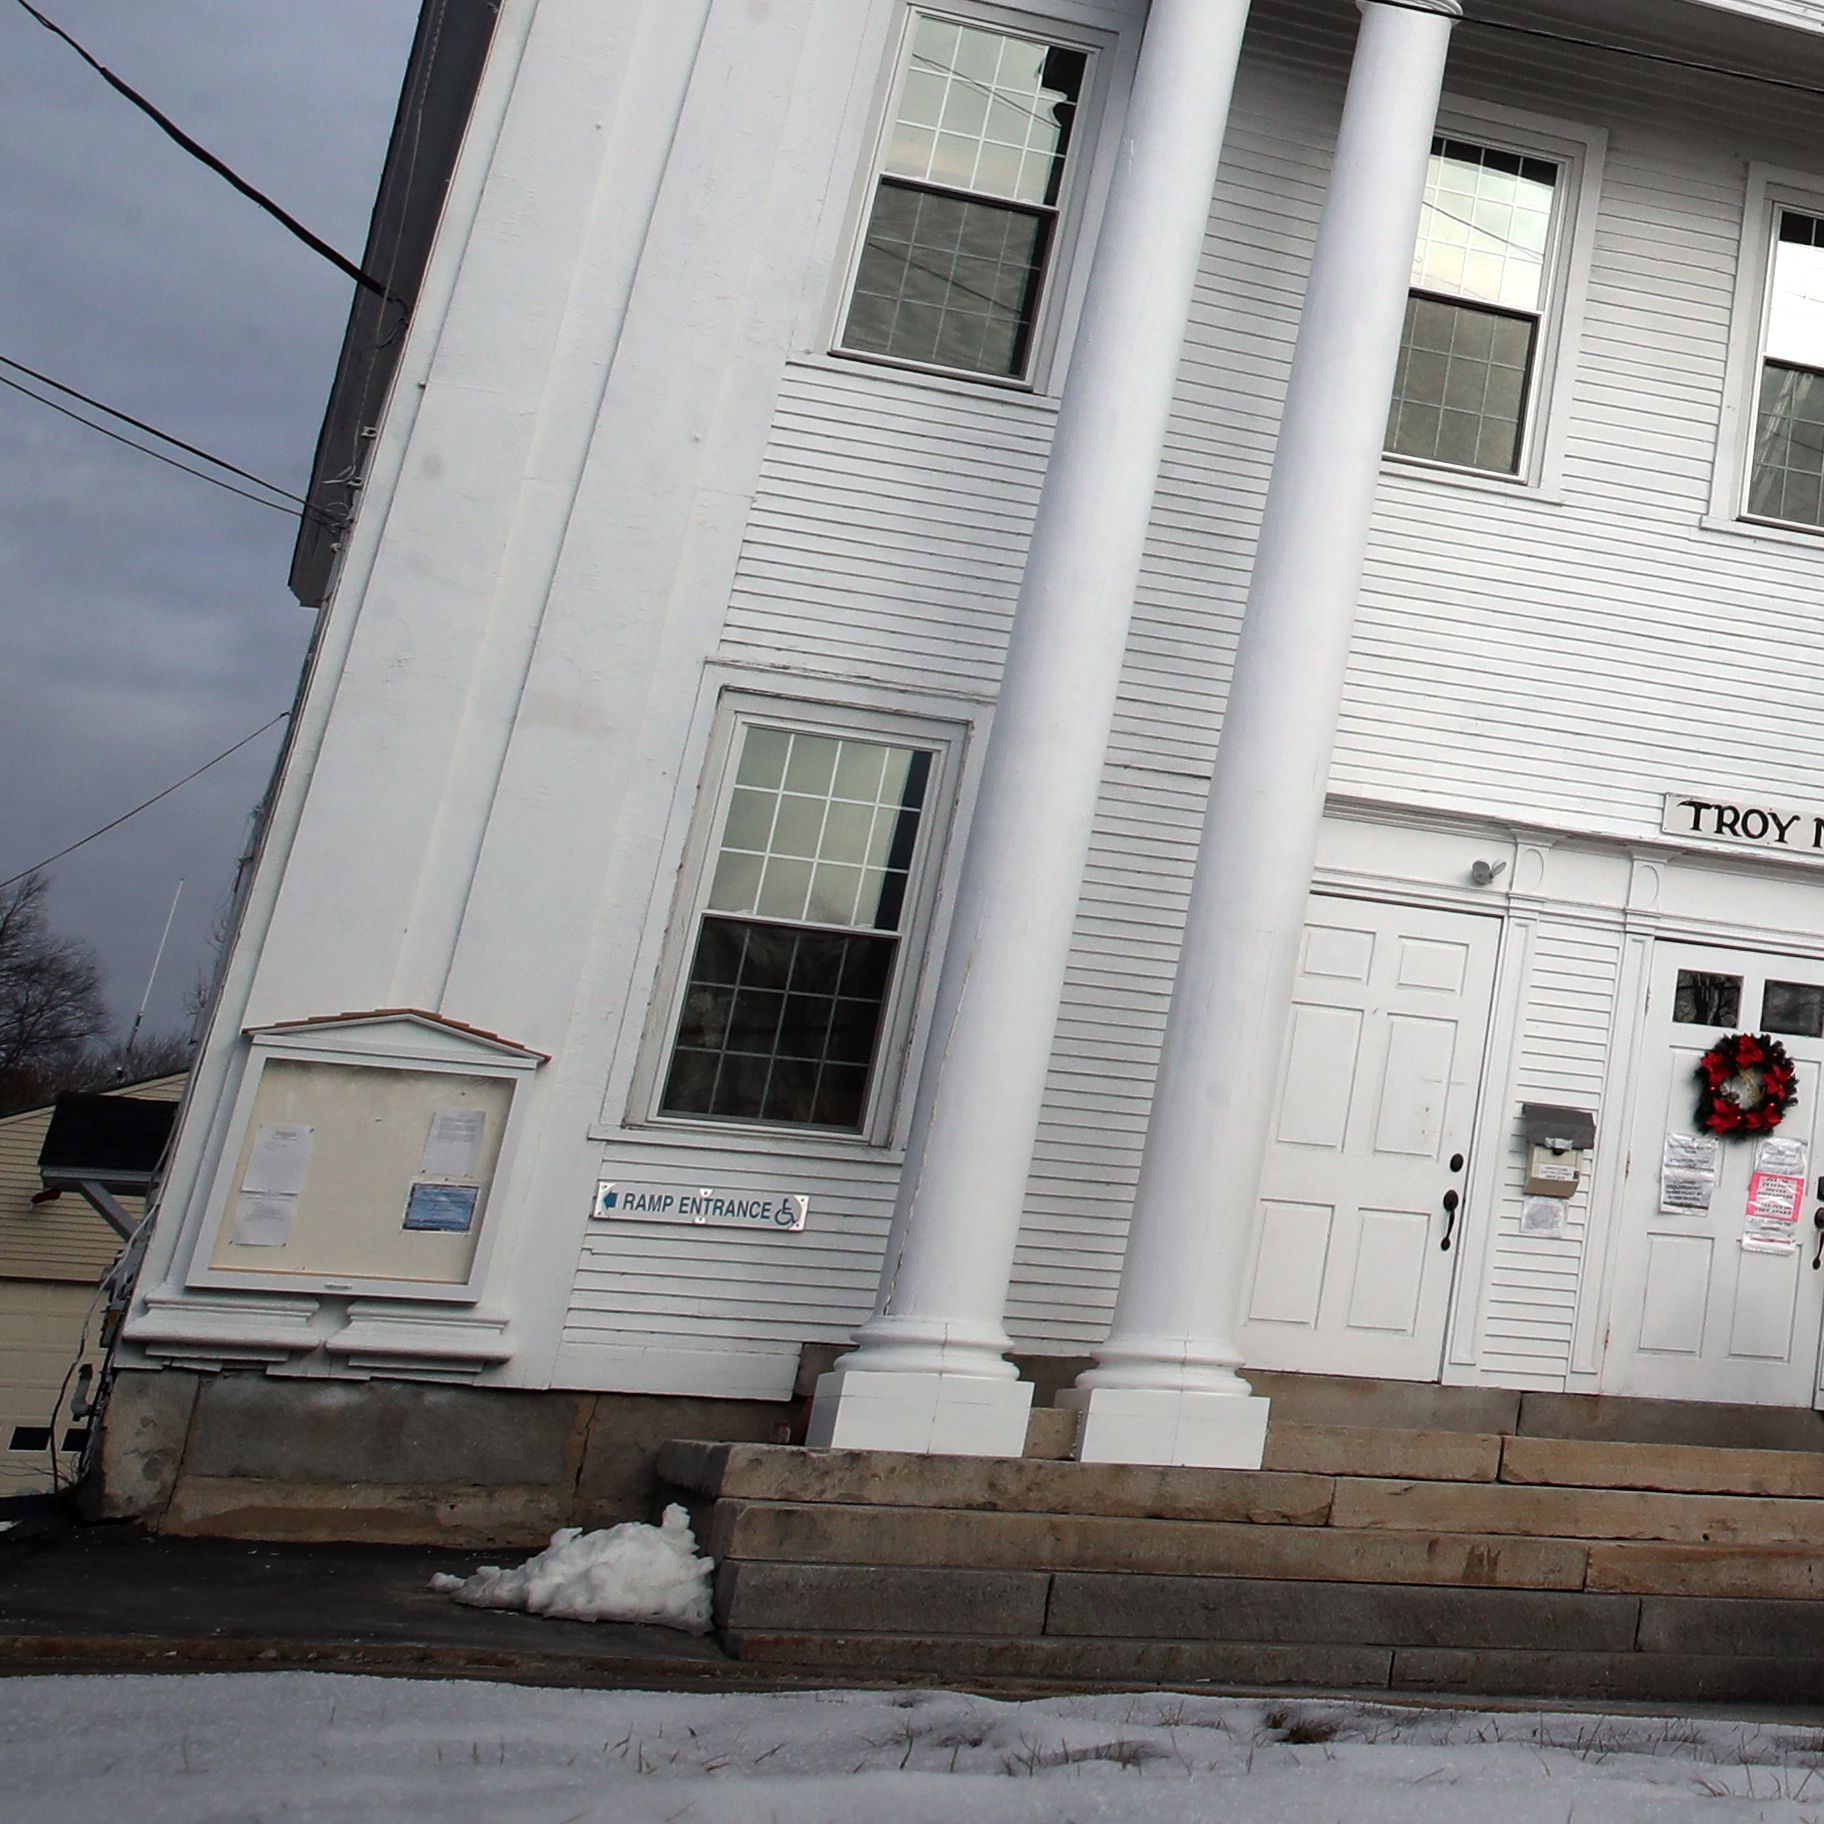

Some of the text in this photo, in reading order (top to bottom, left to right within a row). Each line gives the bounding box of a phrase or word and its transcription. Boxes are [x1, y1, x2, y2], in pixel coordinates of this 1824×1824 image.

[1677, 800, 1801, 844] TROY
[622, 1192, 773, 1220] RAMP ENTRANCE
